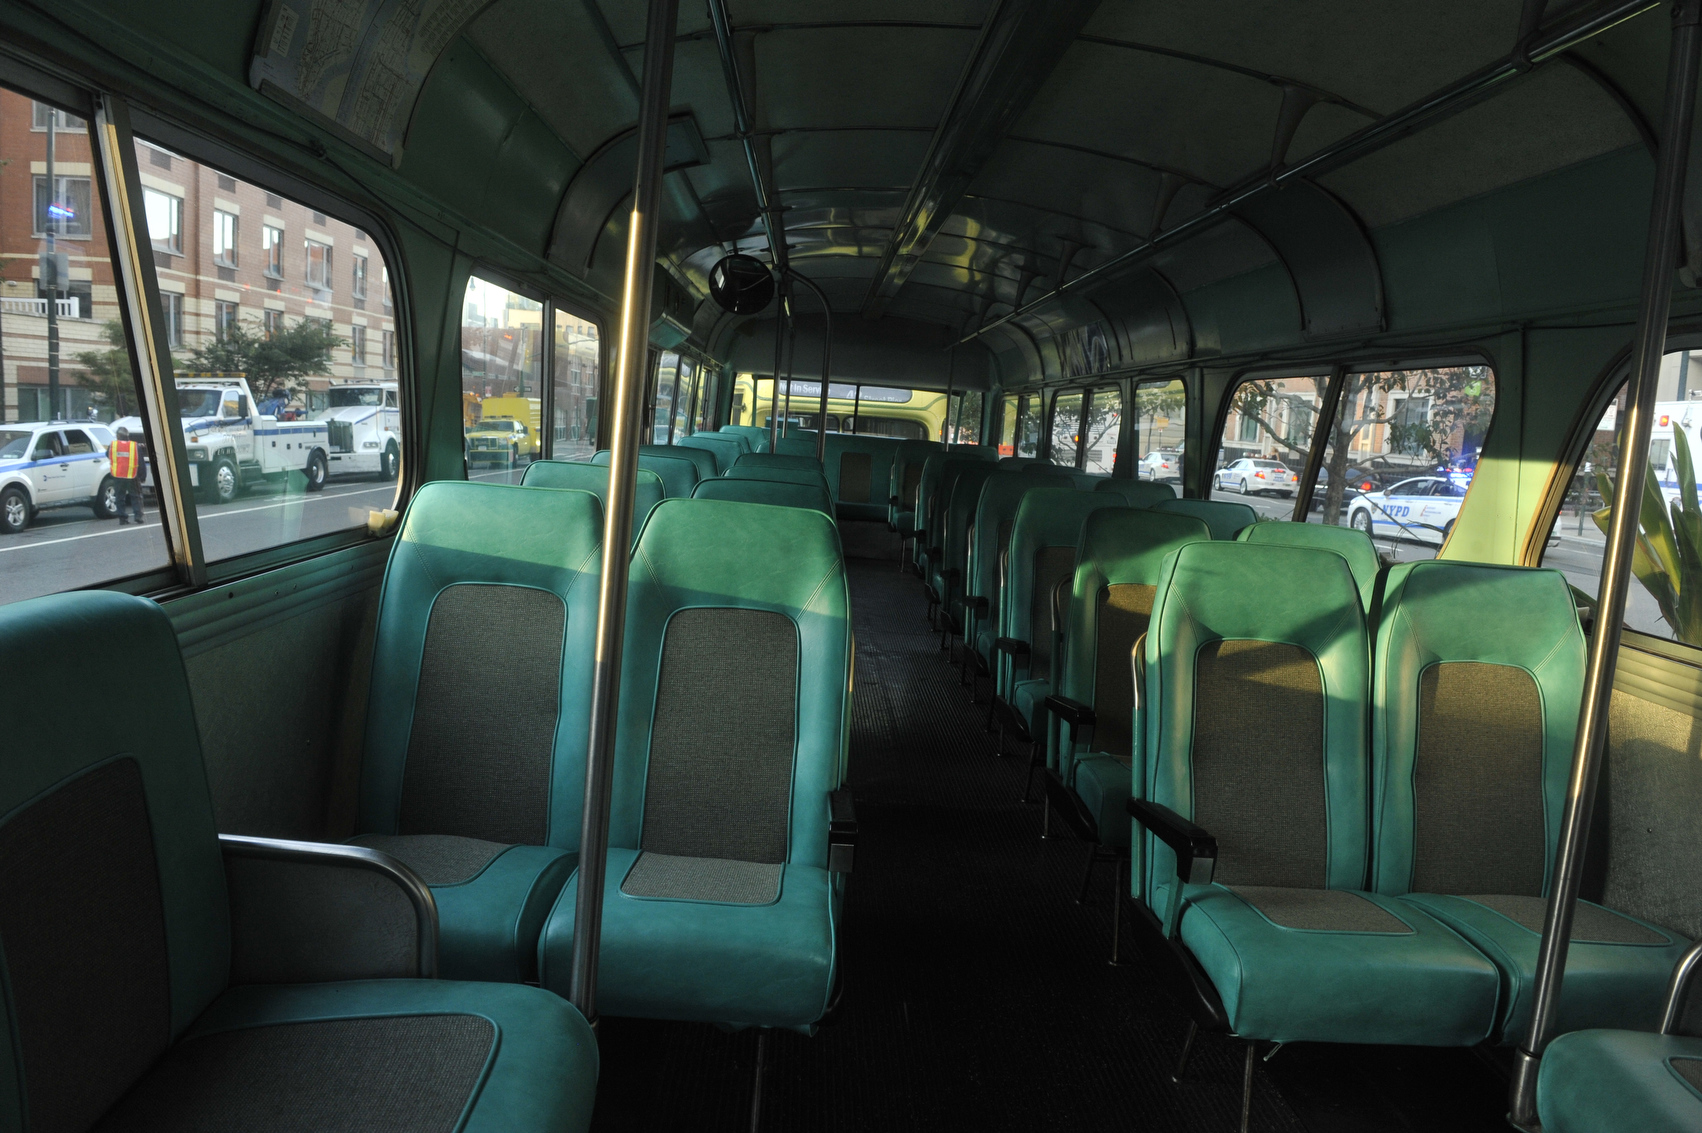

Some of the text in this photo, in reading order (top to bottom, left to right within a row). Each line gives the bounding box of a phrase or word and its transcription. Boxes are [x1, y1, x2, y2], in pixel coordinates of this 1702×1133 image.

[780, 382, 831, 395] Nt In Servie
[1381, 504, 1410, 518] NYPD
